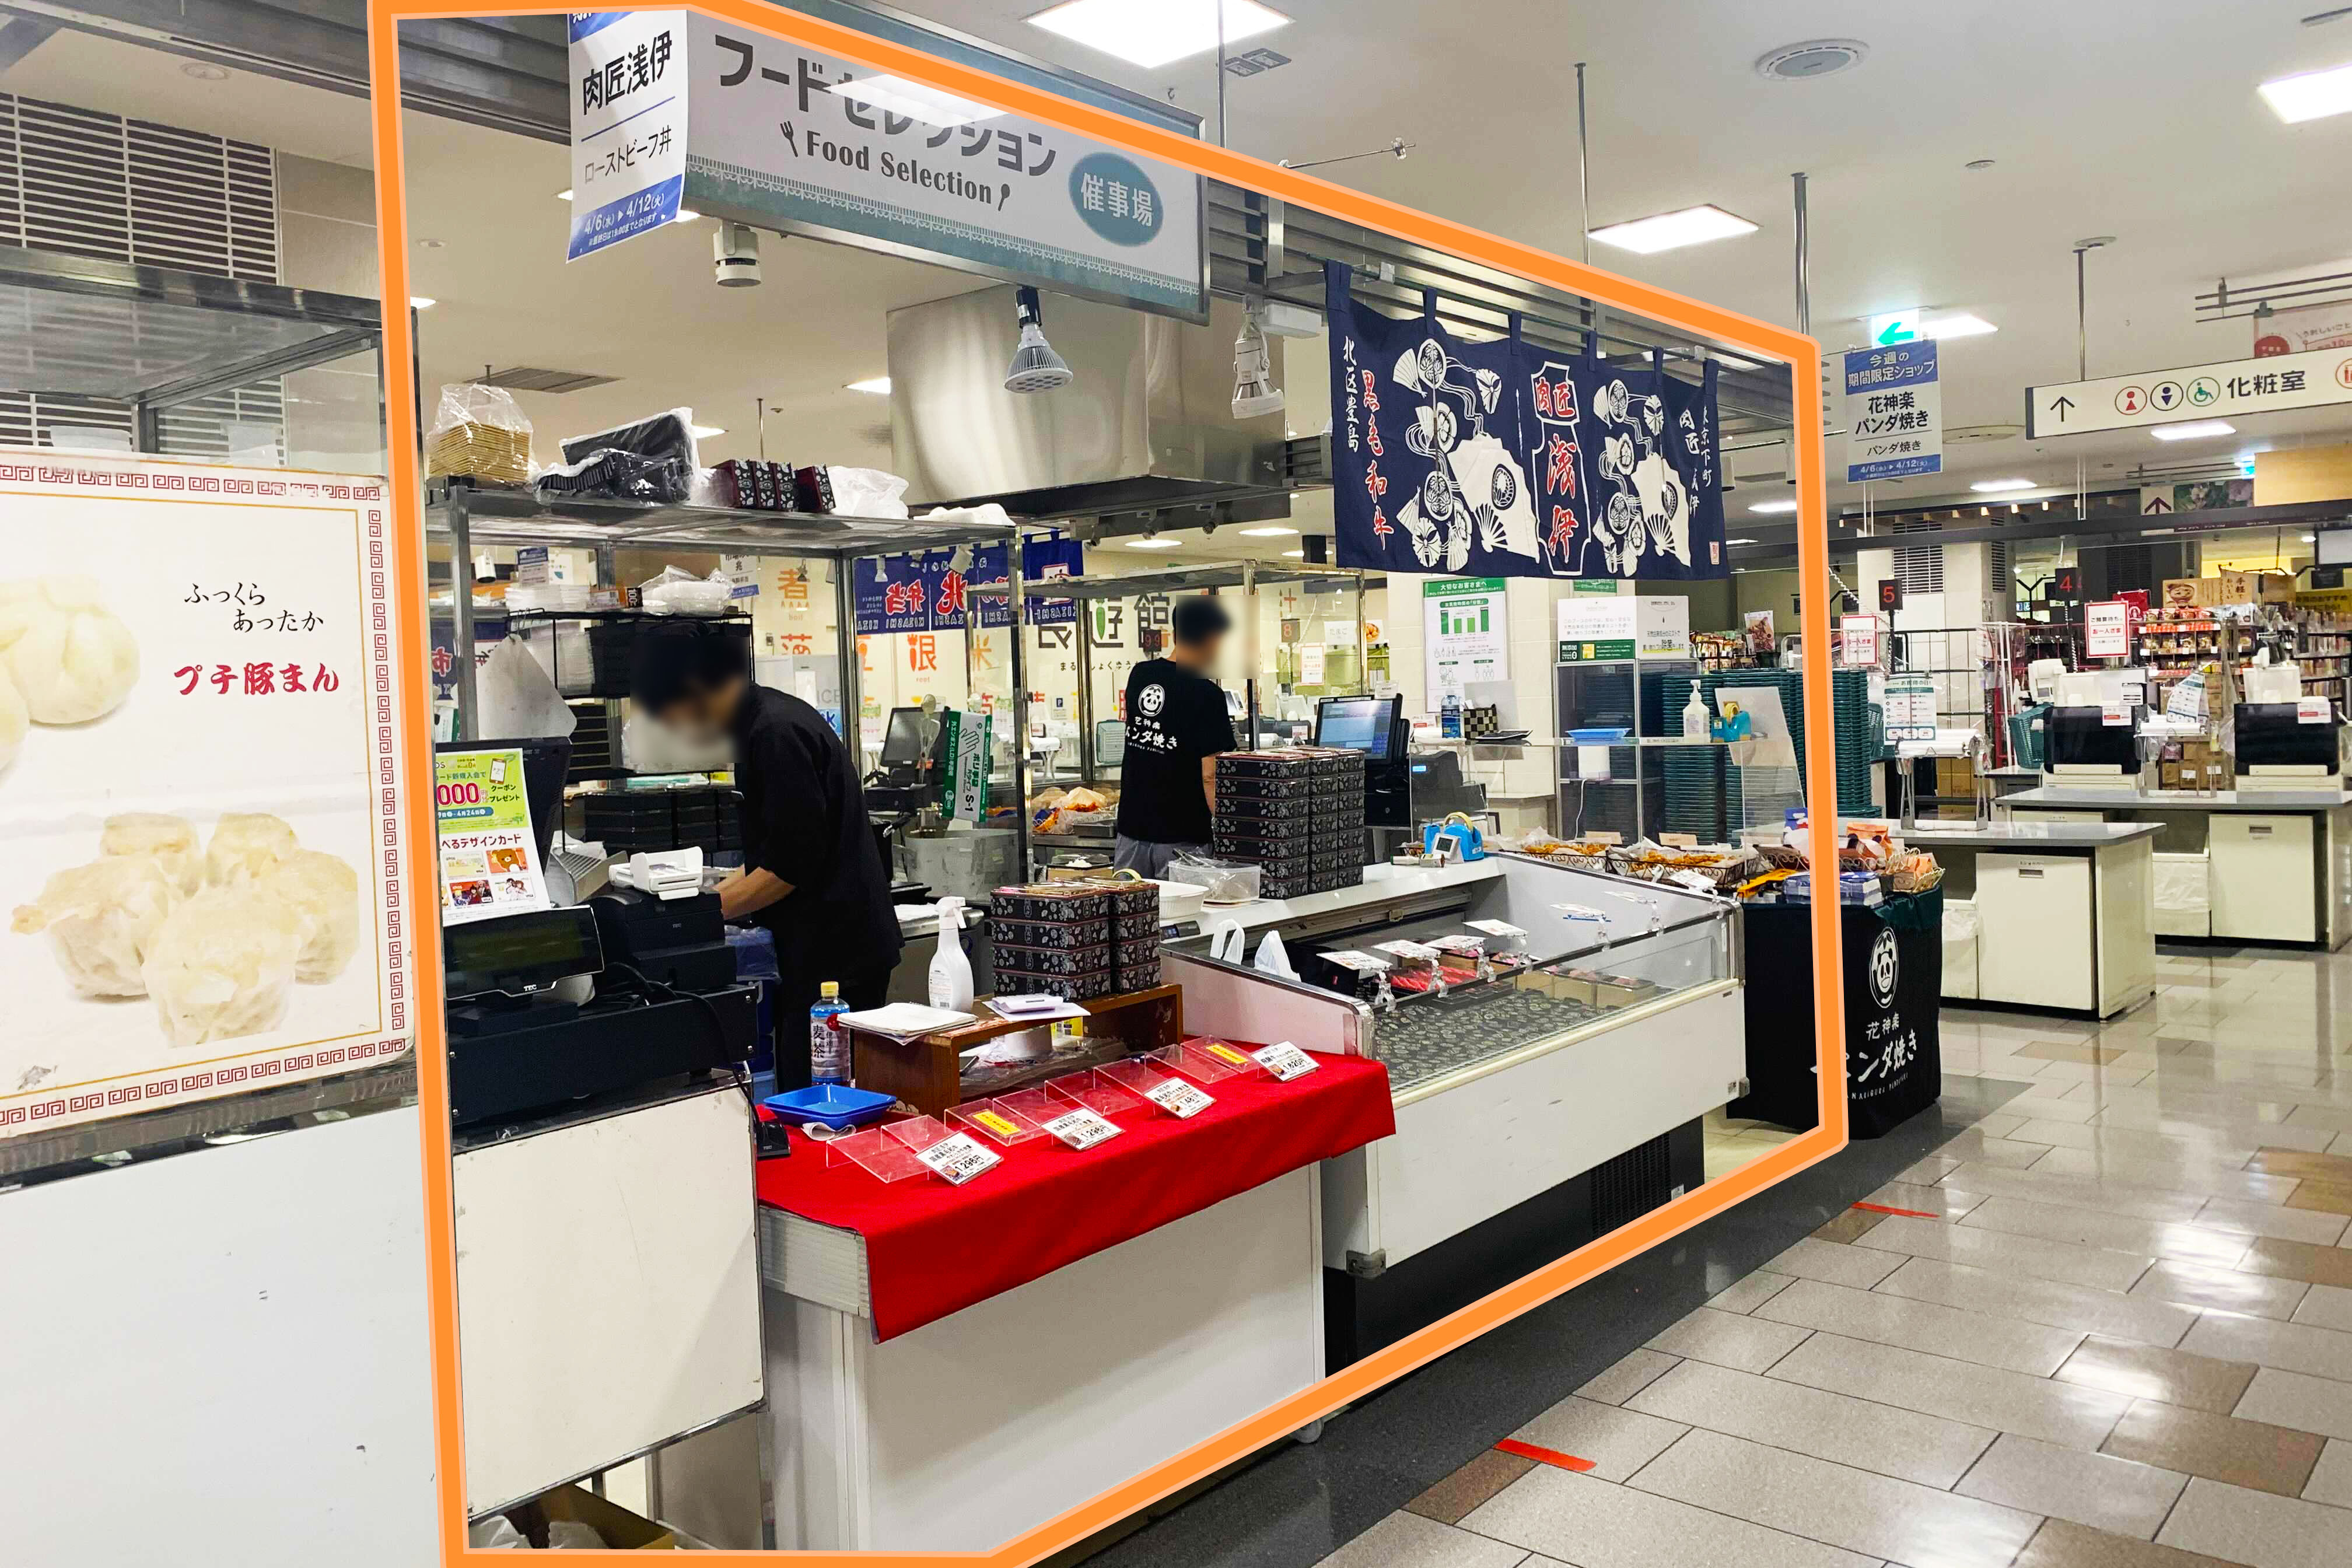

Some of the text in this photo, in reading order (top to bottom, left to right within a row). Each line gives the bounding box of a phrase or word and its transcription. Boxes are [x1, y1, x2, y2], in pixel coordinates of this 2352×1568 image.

[583, 30, 672, 116] 肉匠浅伊
[584, 124, 672, 184] ローストビーフ丼
[807, 131, 992, 204] Food Selection
[1081, 171, 1153, 228] 催事場
[1848, 359, 1936, 387] 期間限定ショップ
[1870, 351, 1909, 368] 今週の
[1343, 335, 1360, 453] 北区豊島
[1535, 376, 1577, 418] 肉匠
[2227, 370, 2306, 399] 化粧室
[1868, 391, 1915, 415] 花神楽
[1855, 410, 1929, 435] パンダ焼き
[1362, 369, 1395, 551] 黒毛和牛
[1867, 440, 1922, 456] パンダ焼き
[184, 583, 267, 606] ふっくら
[1440, 581, 1487, 591] 大切なお客さまへ
[1882, 586, 1896, 603] 5
[2059, 575, 2073, 593] 4
[233, 608, 324, 634] あったか
[173, 662, 340, 696] プチ豚まん
[489, 794, 520, 803] プレゼント
[491, 784, 516, 792] クーポン
[965, 794, 975, 813] S-1
[1866, 1012, 1899, 1041] 花神楽
[813, 1024, 825, 1058] 麦茶
[1845, 1028, 1917, 1083] ンダ焼き
